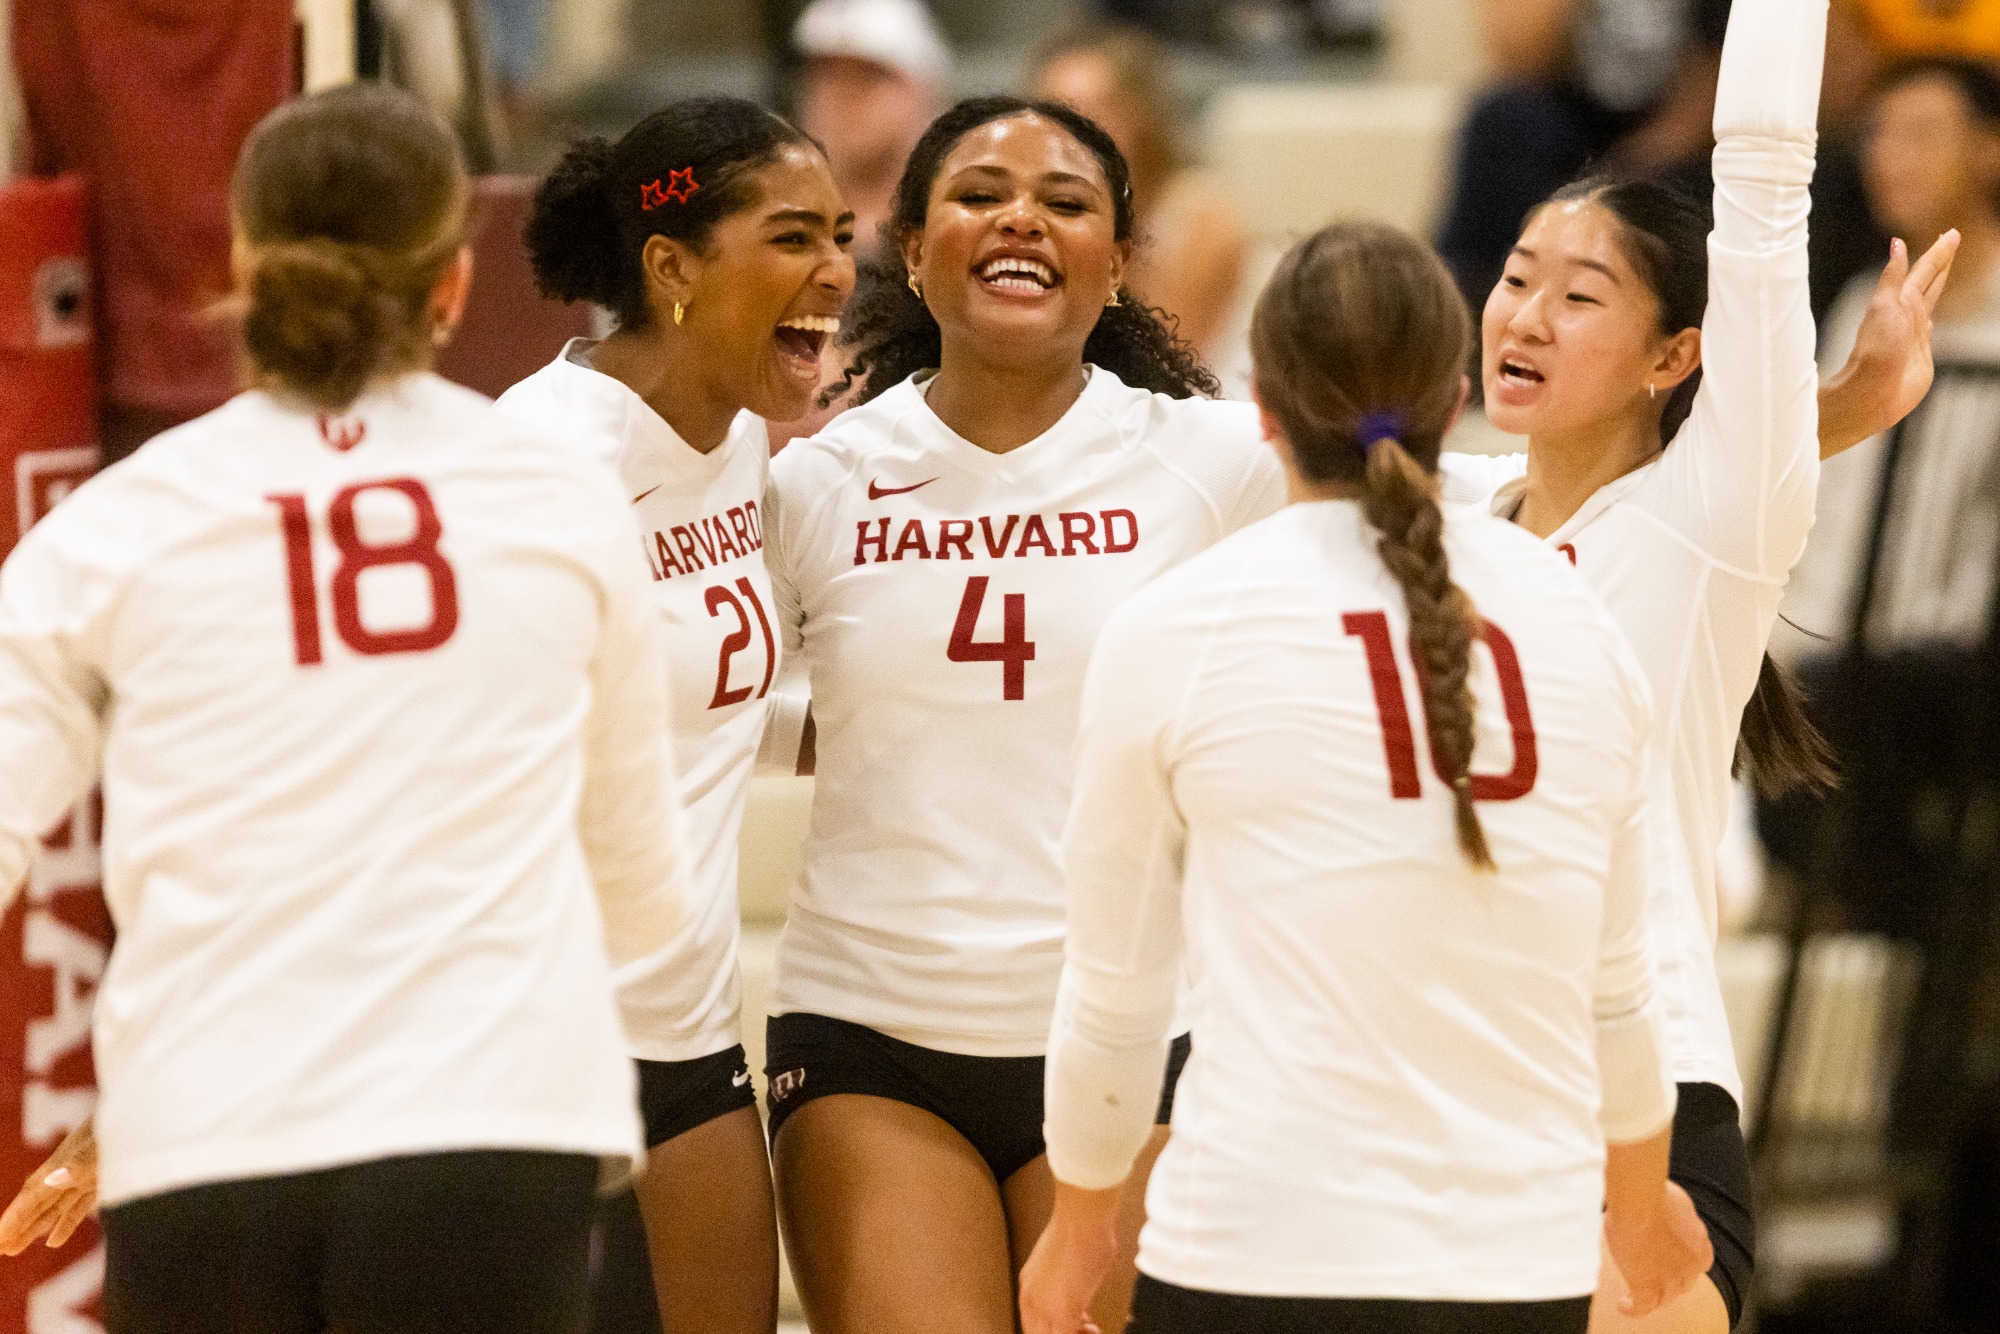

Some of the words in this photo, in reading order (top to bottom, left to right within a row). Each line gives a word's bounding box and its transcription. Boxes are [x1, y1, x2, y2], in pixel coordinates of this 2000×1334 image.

[265, 476, 460, 667] 18
[853, 508, 1140, 566] HARVARD
[703, 576, 776, 710] 21
[946, 575, 1036, 701] 4
[1340, 610, 1539, 803] 10
